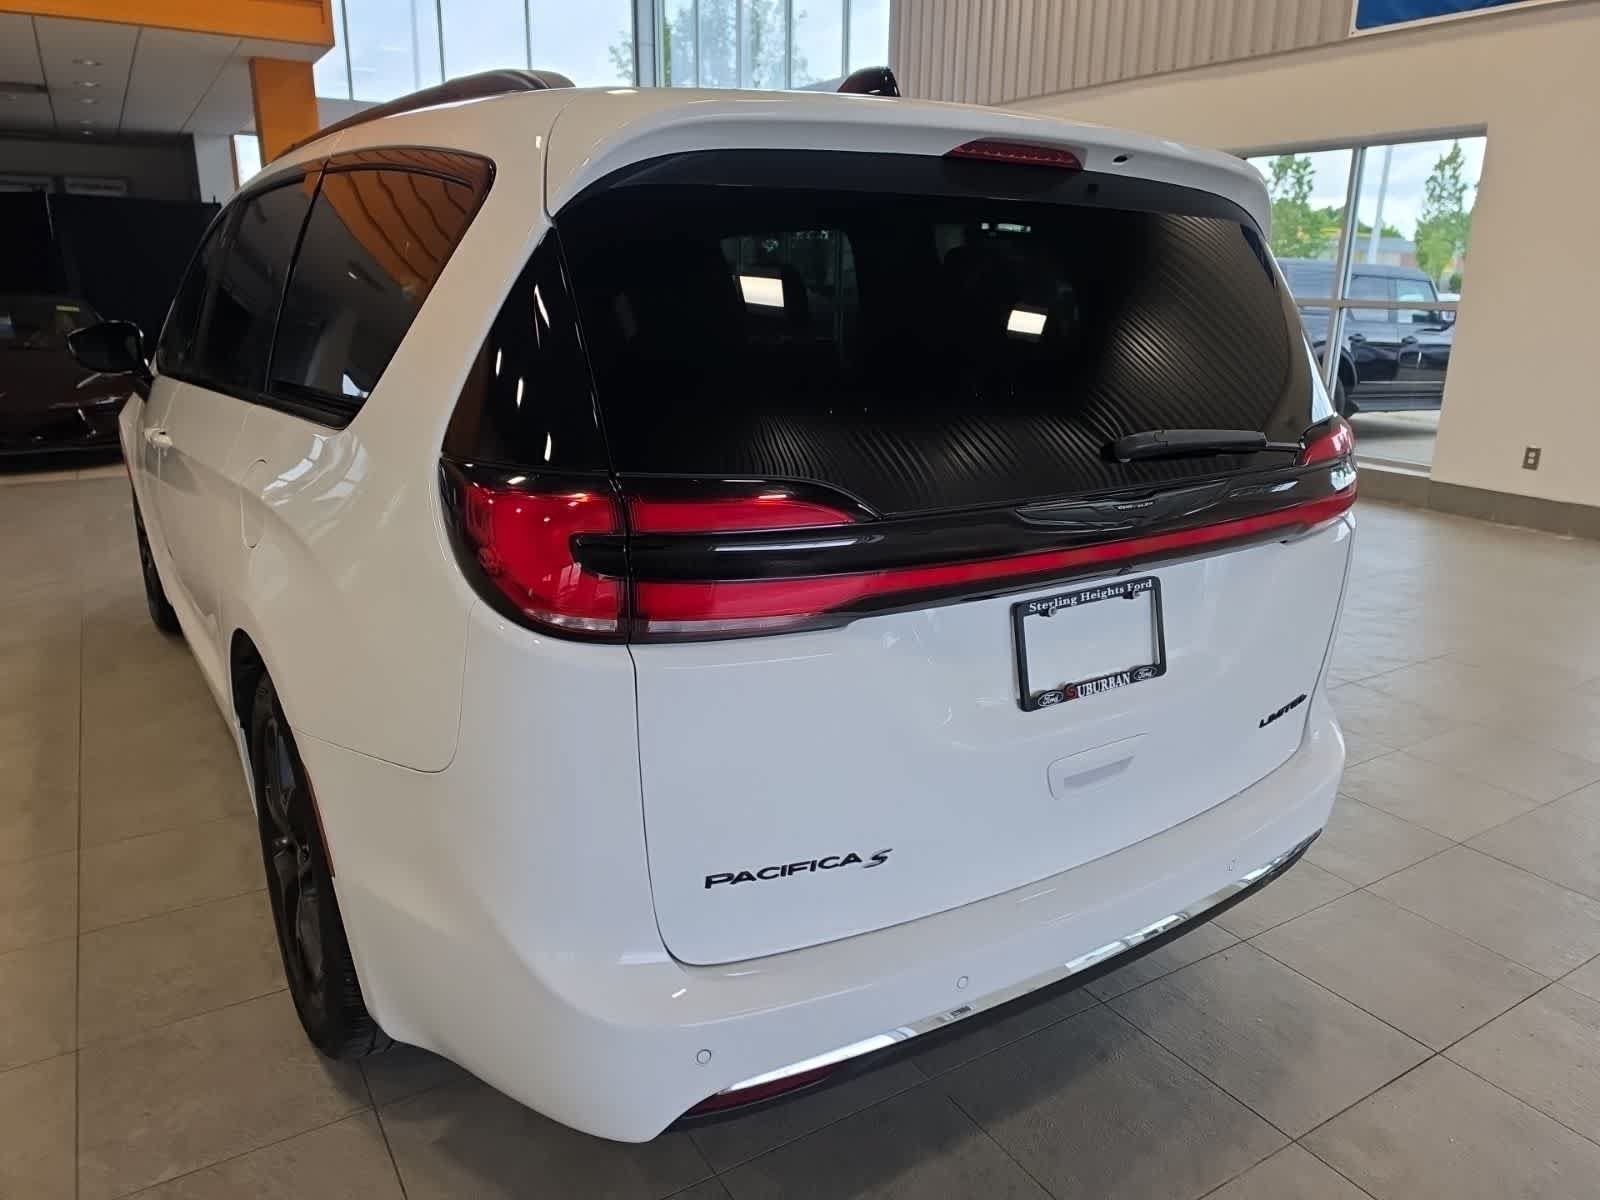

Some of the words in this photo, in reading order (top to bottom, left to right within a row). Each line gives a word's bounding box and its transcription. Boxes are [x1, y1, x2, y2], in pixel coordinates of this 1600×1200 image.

[1029, 596, 1077, 612] Sterling
[1080, 586, 1124, 601] Heights
[1126, 579, 1153, 592] Ford
[1065, 672, 1131, 698] SUBURBAN
[705, 853, 862, 889] PACIFICA
[862, 848, 894, 869] S
